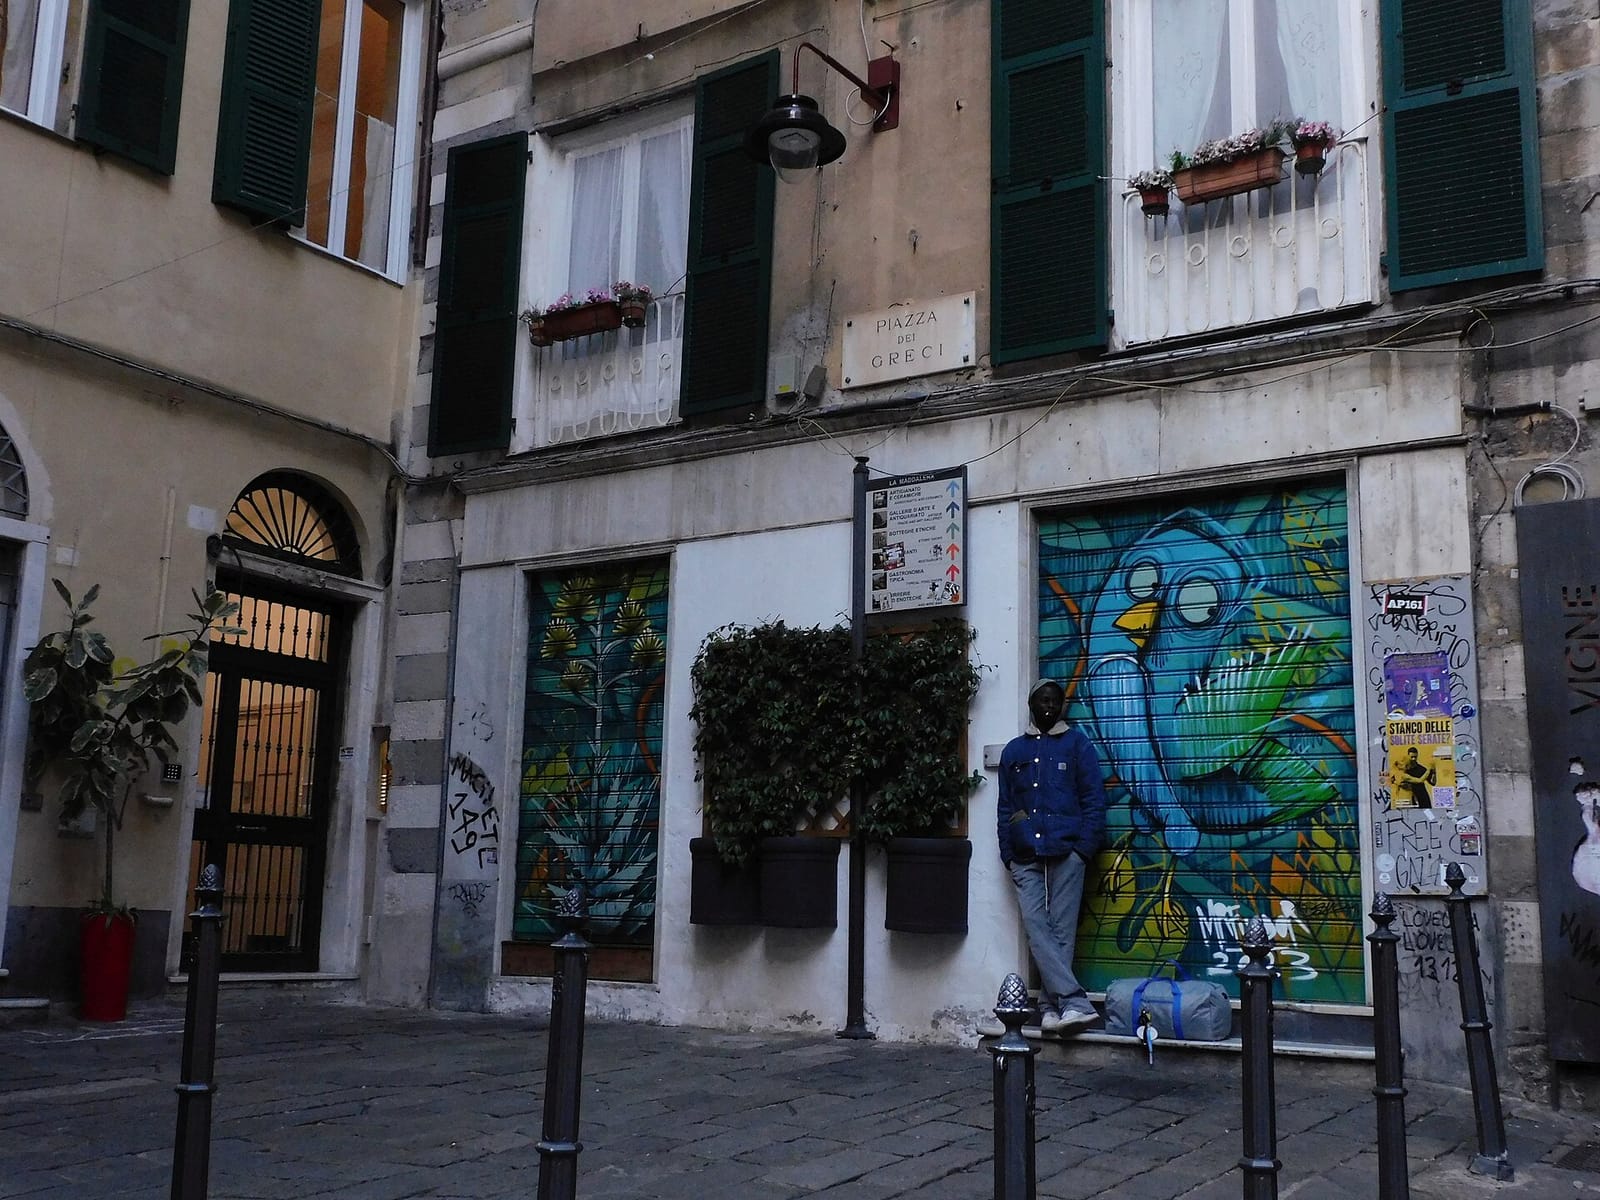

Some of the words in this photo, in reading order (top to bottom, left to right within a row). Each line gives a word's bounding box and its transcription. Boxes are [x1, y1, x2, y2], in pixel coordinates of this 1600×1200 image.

[876, 311, 937, 333] PIAZZA
[897, 333, 915, 344] DEI
[871, 344, 943, 368] GRECI
[1387, 599, 1423, 610] AP161
[1389, 721, 1422, 735] STANCO
[1425, 720, 1450, 733] DELLE
[1390, 734, 1416, 746] SOLITE
[1418, 733, 1450, 745] SERATE?
[1386, 817, 1442, 855] FREE
